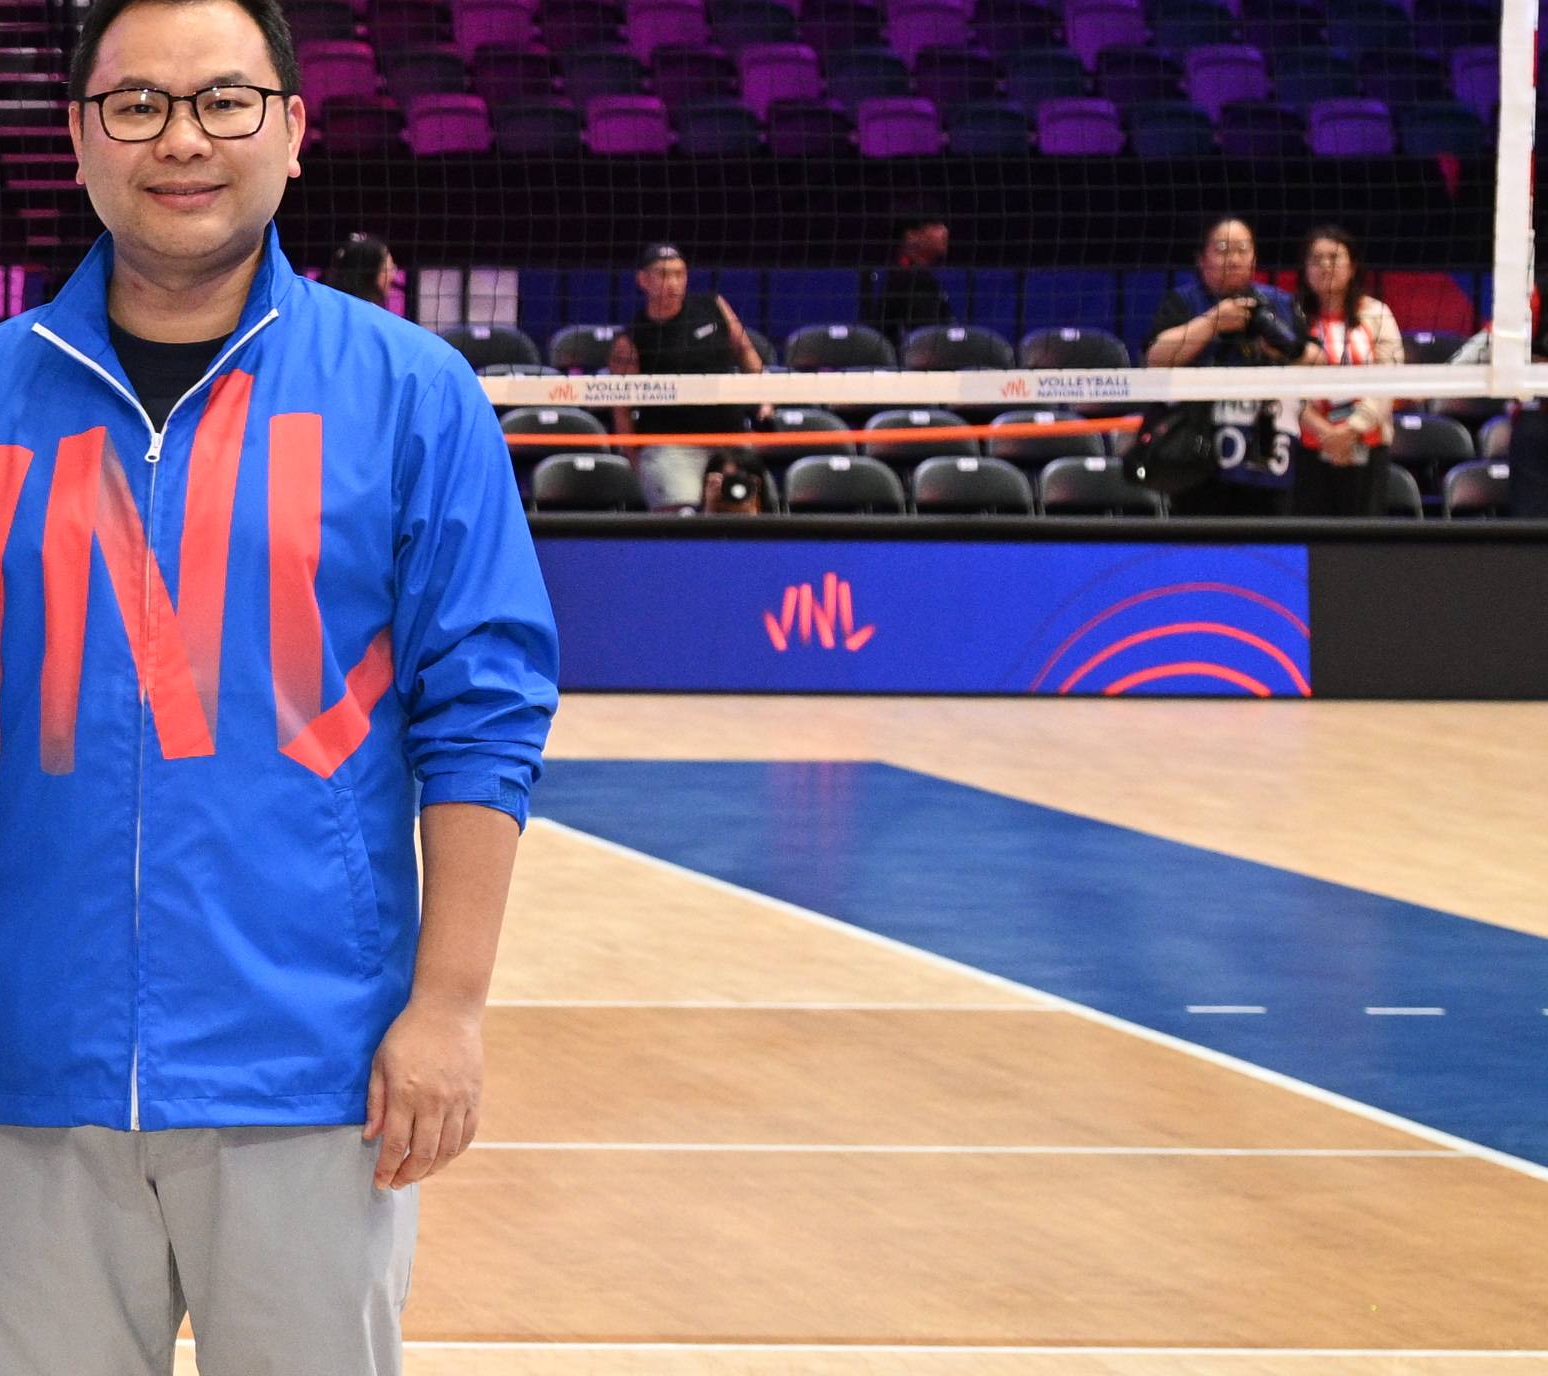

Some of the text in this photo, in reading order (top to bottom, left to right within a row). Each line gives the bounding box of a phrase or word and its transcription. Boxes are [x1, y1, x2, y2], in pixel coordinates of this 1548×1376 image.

[586, 382, 676, 392] VOLLEYBALL
[1038, 378, 1130, 388] VOLLEYBALL
[763, 571, 876, 652] VNL
